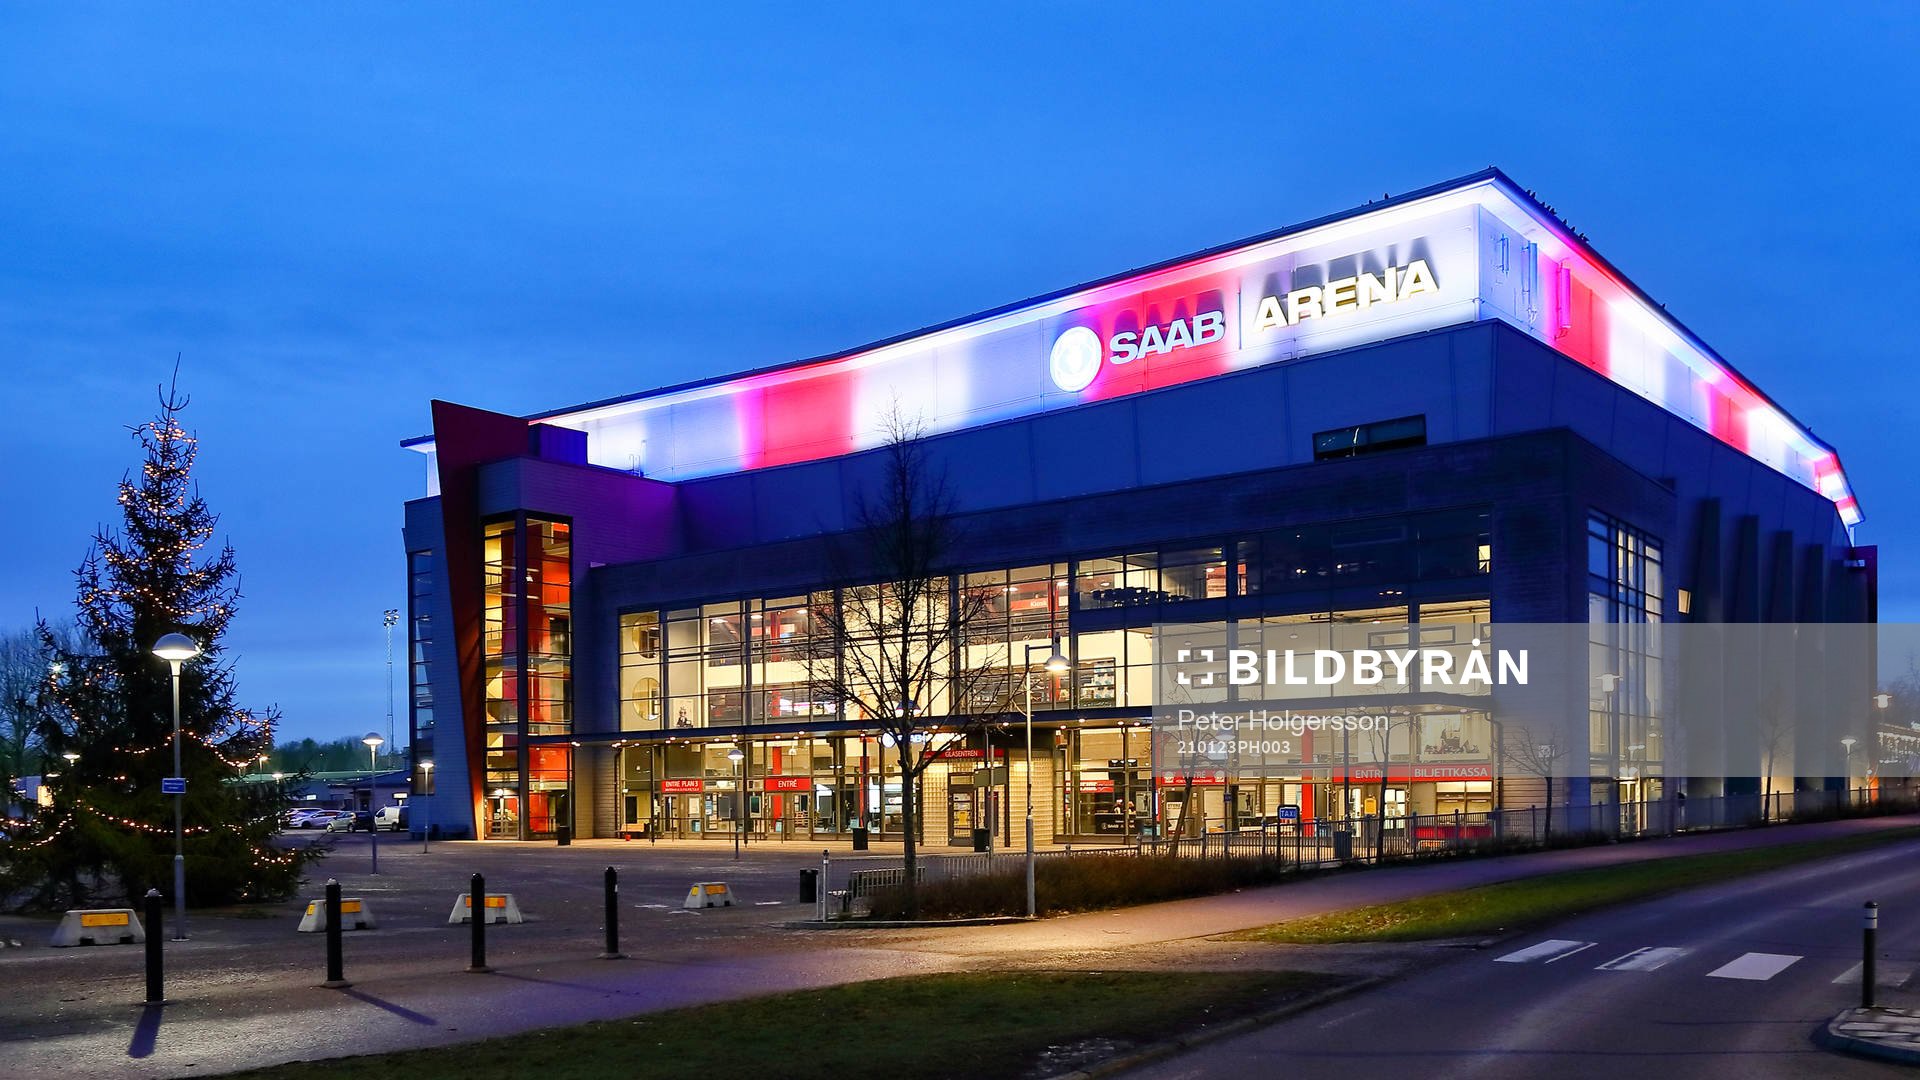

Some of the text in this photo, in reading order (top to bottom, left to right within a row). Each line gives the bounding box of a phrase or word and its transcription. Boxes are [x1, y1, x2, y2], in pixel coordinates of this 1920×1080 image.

[1109, 259, 1440, 365] SAAB ARENA
[1414, 767, 1488, 777] BILJETTKASSA
[778, 779, 797, 788] ENTRÉ
